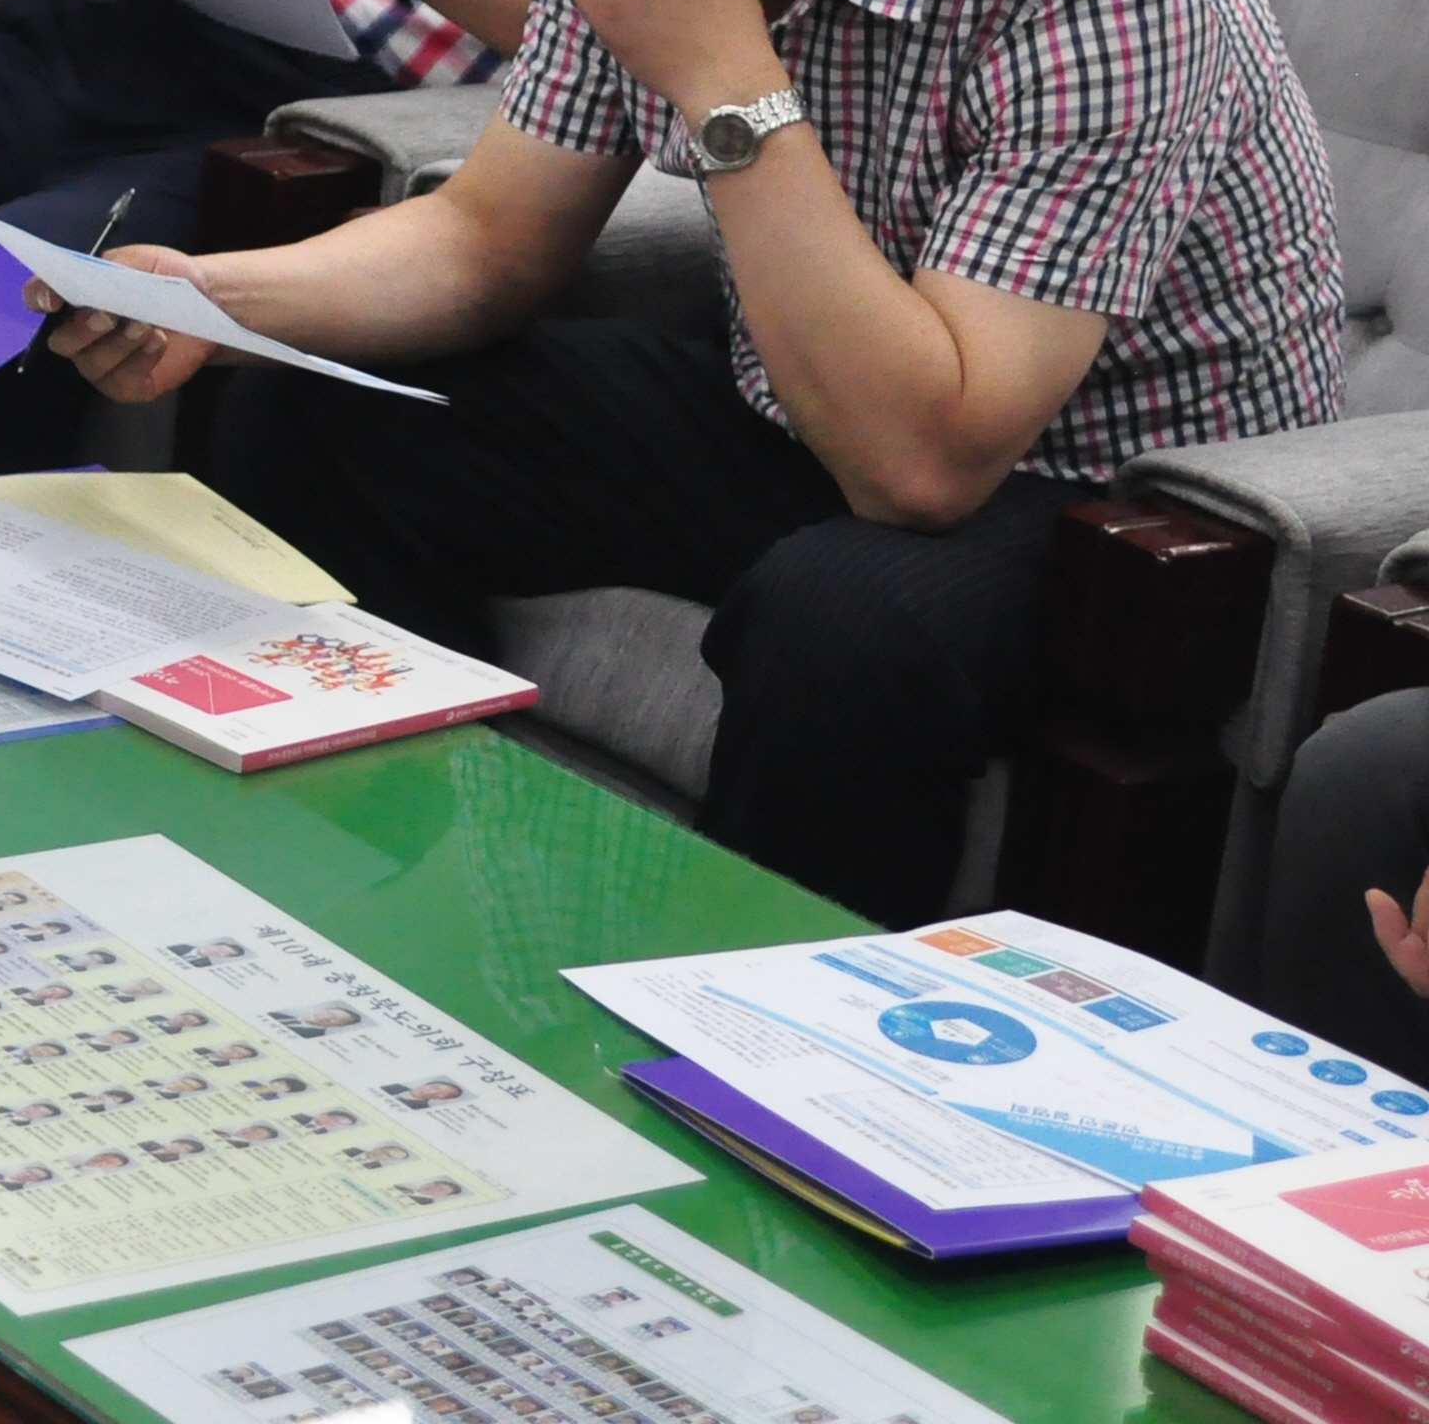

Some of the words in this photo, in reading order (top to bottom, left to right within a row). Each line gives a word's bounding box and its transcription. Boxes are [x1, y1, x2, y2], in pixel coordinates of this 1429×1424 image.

[252, 923, 332, 968] 제10대
[324, 971, 464, 1051] 충청북도의회
[458, 1054, 537, 1100] 구성표
[1010, 1102, 1070, 1122] 설명회
[1077, 1115, 1140, 1135] 언론인
